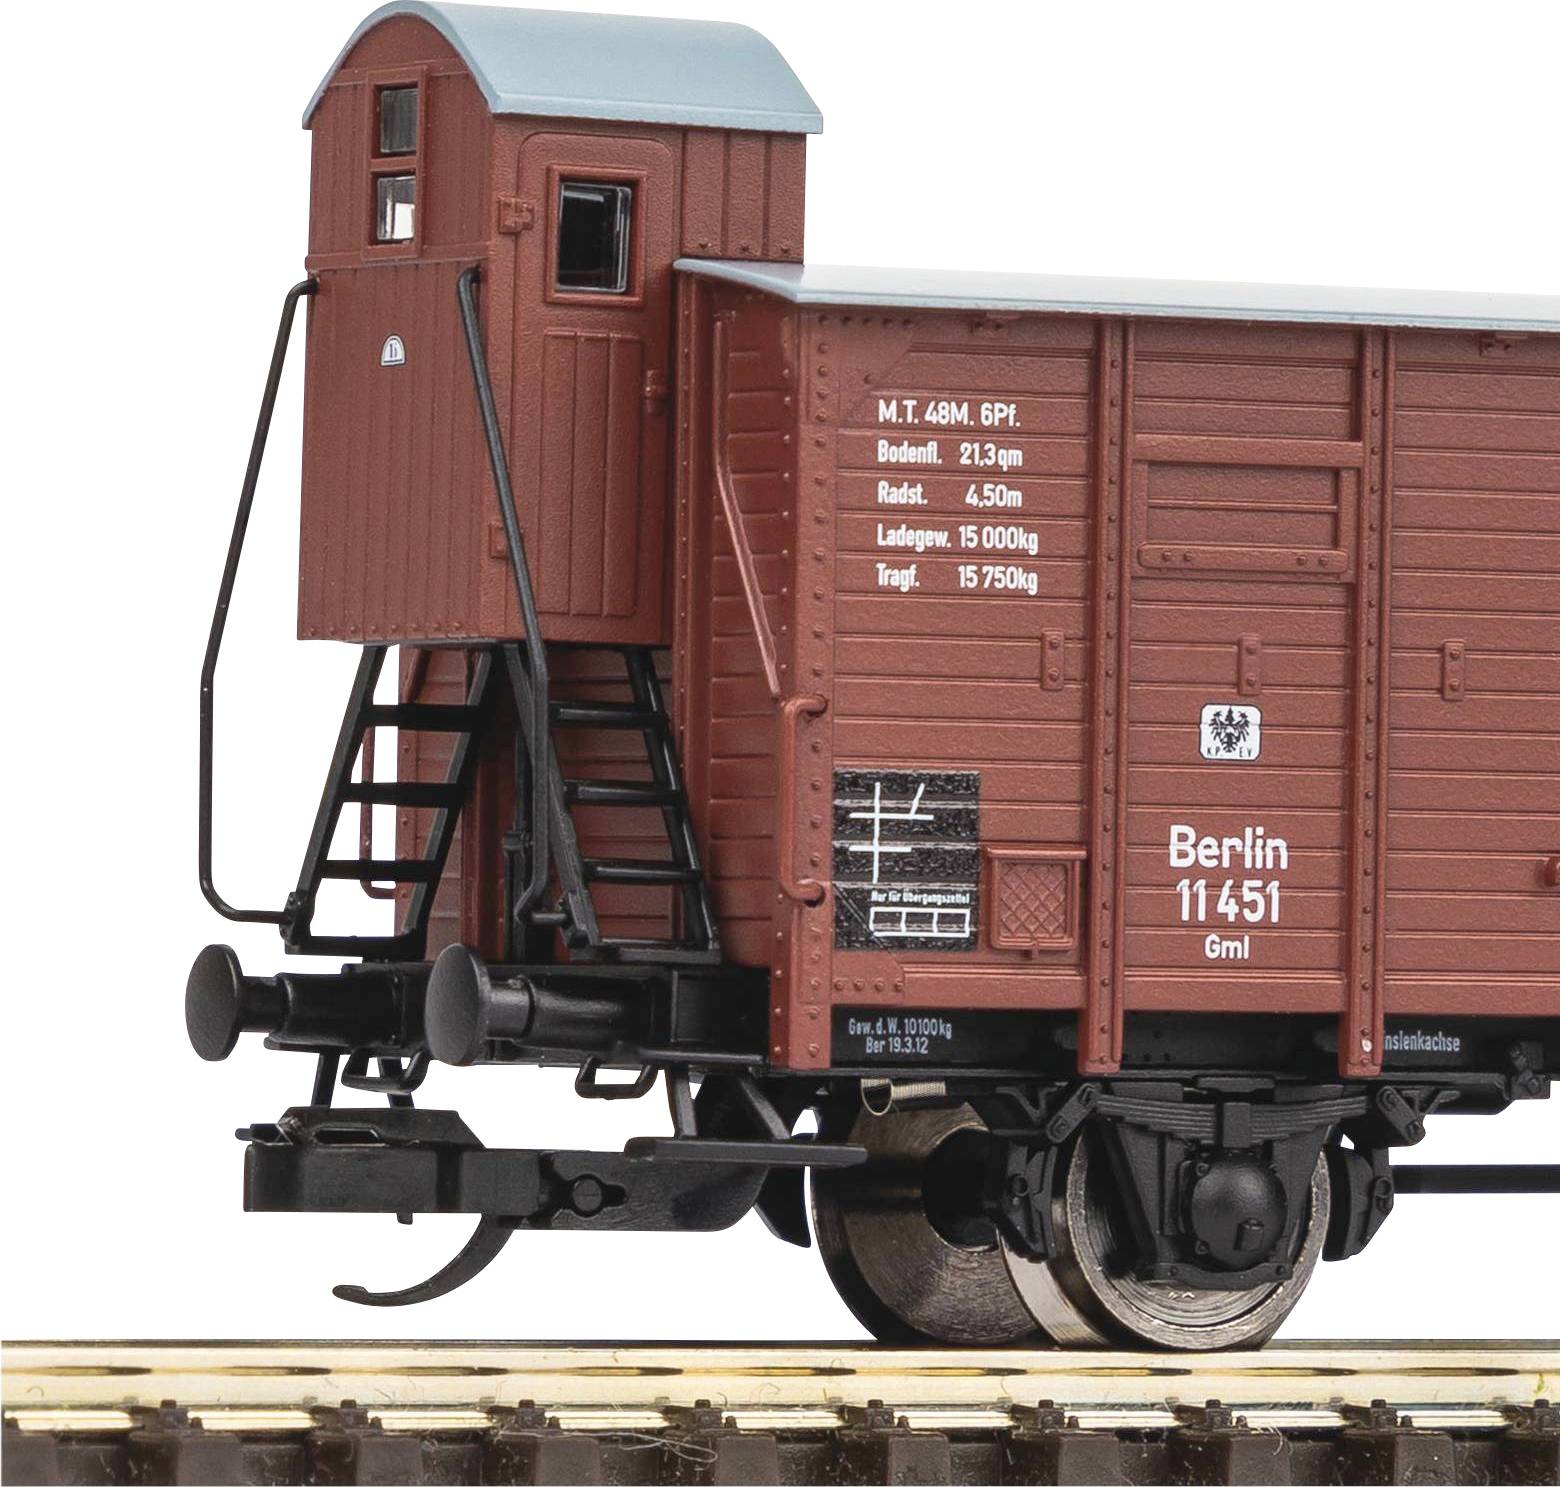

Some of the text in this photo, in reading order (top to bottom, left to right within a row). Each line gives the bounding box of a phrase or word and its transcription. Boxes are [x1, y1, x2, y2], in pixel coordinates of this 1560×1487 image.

[878, 399, 1021, 427] M.T. 48M. 6Pf.
[877, 439, 943, 464] Bodenfl.
[877, 480, 1023, 508] Radst. 4,50m
[877, 523, 952, 552] Ladegew.
[876, 563, 920, 592] Tragf.
[1169, 824, 1289, 870] Berlin
[1204, 934, 1250, 960] Gml
[865, 1037, 929, 1055] Ber 19.3.12
[1384, 1030, 1461, 1052] nslenkachse
